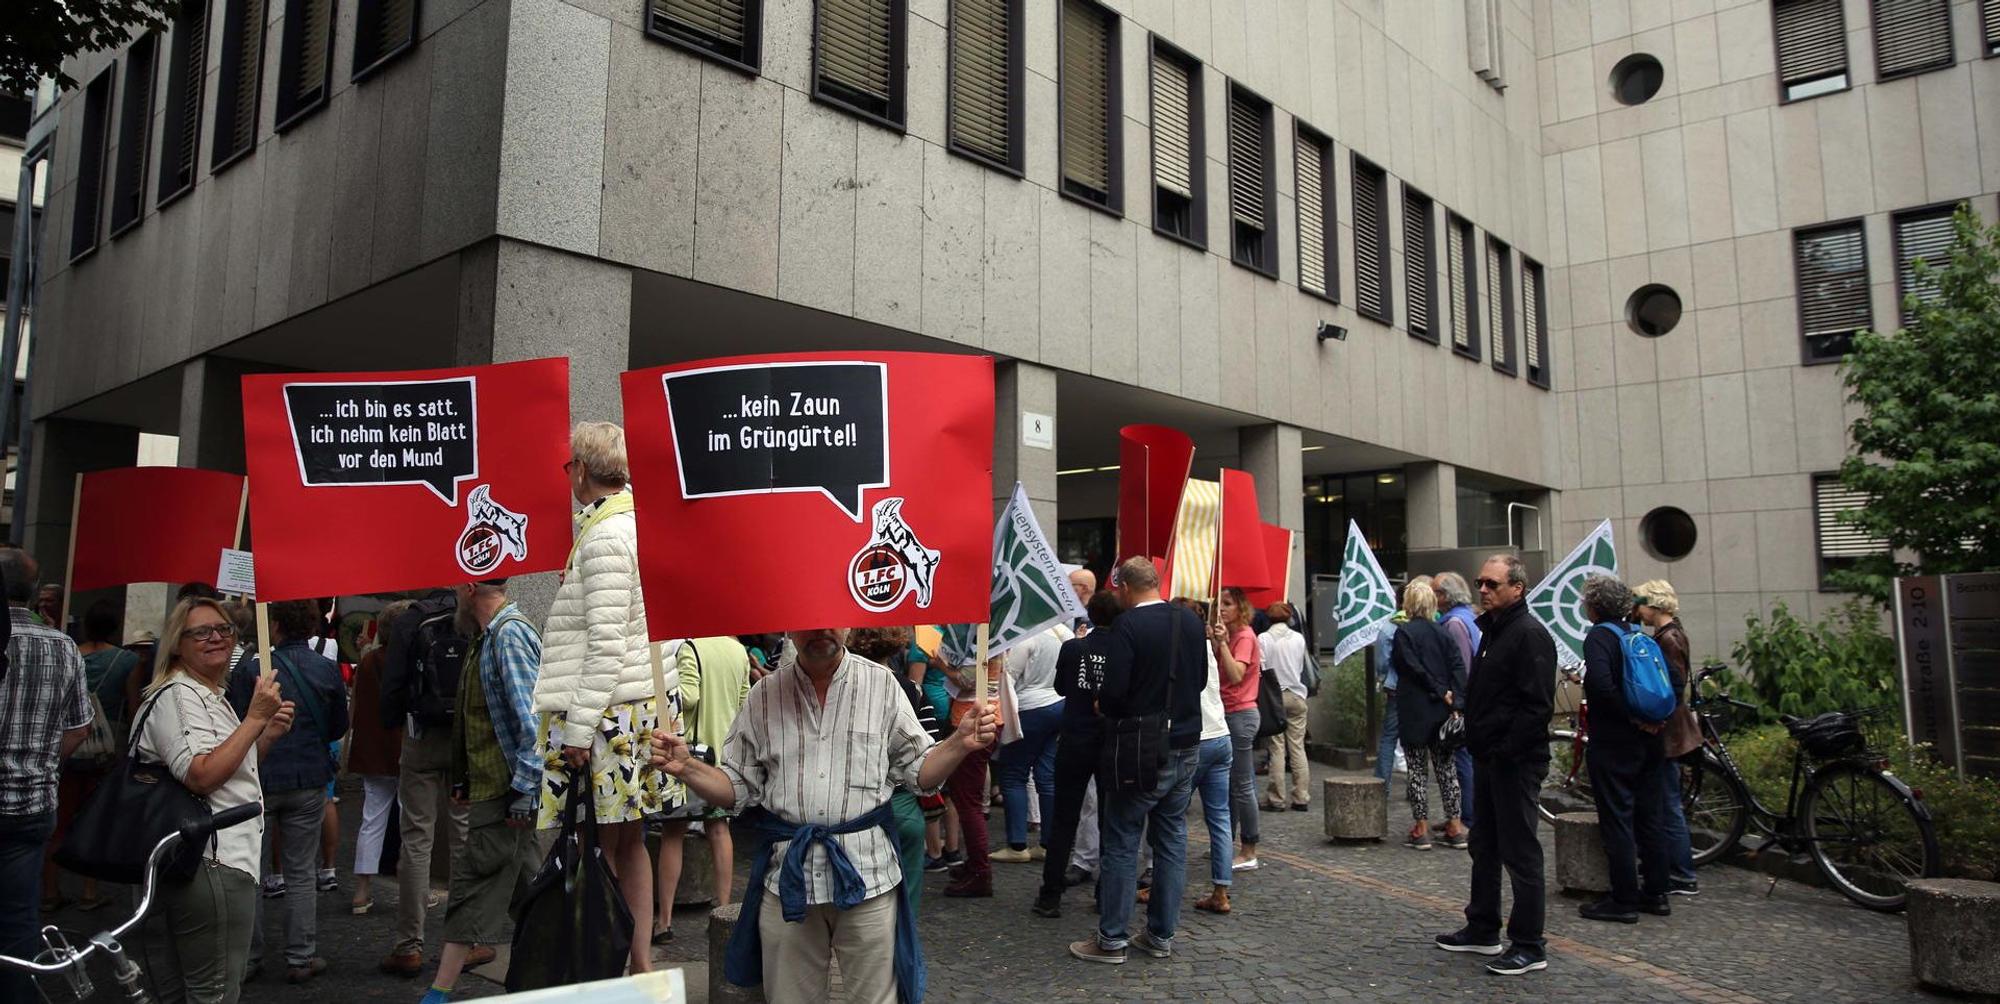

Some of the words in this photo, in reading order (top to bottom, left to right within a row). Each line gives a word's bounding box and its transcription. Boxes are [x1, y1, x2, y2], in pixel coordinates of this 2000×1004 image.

[365, 399, 387, 418] bin
[393, 403, 413, 418] es
[418, 398, 458, 417] satt.
[789, 391, 840, 417] Zaun
[310, 424, 334, 444] ich
[340, 425, 384, 444] nehm
[389, 424, 422, 443] kein
[427, 421, 467, 442] Blatt
[708, 429, 731, 452] im
[739, 422, 857, 452] Grüngürtel!
[1035, 419, 1041, 434] 8
[338, 453, 363, 469] vor
[369, 448, 397, 468] den
[403, 446, 443, 468] Mund
[473, 549, 491, 566] KÖLN
[867, 583, 891, 597] KÖLN
